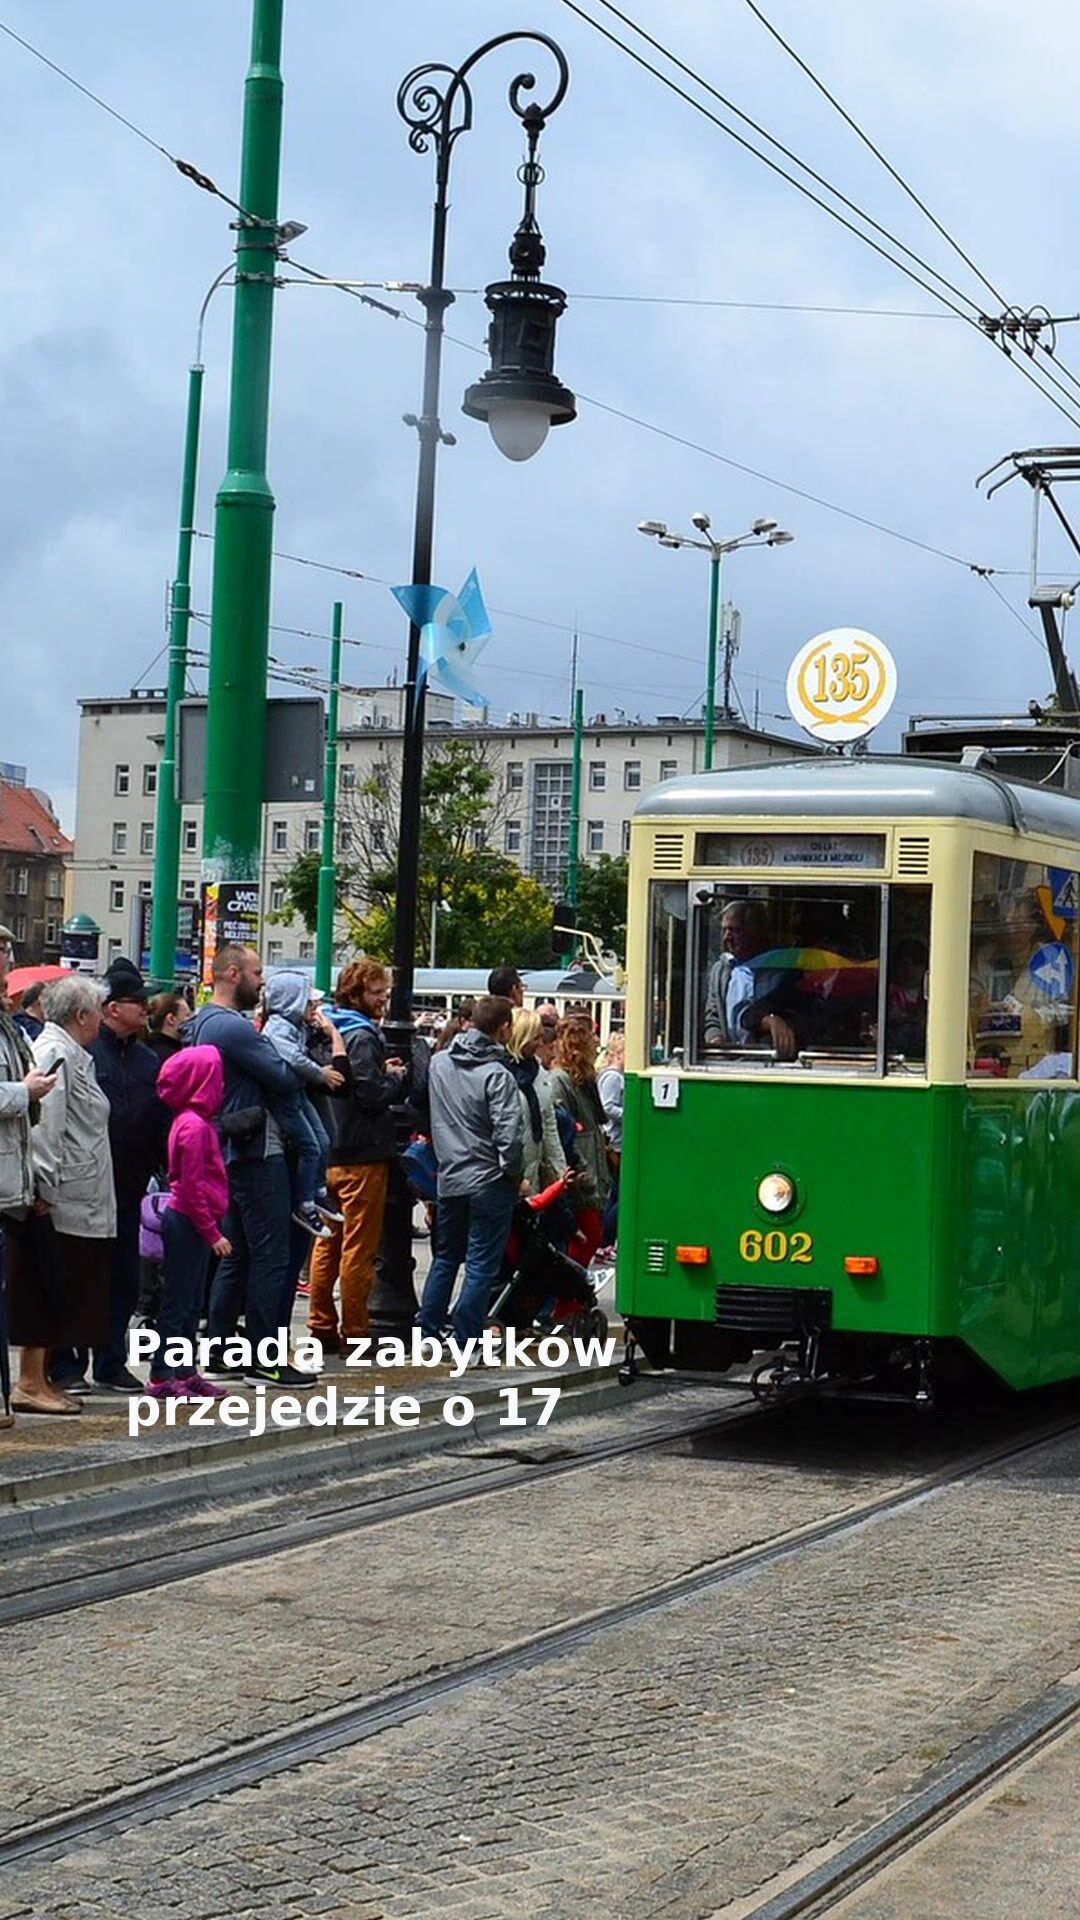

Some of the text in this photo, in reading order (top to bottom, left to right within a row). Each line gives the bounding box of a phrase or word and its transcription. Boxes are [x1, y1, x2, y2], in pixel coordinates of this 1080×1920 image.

[813, 652, 870, 702] 135
[661, 1083, 670, 1100] 1
[738, 1229, 815, 1264] 602
